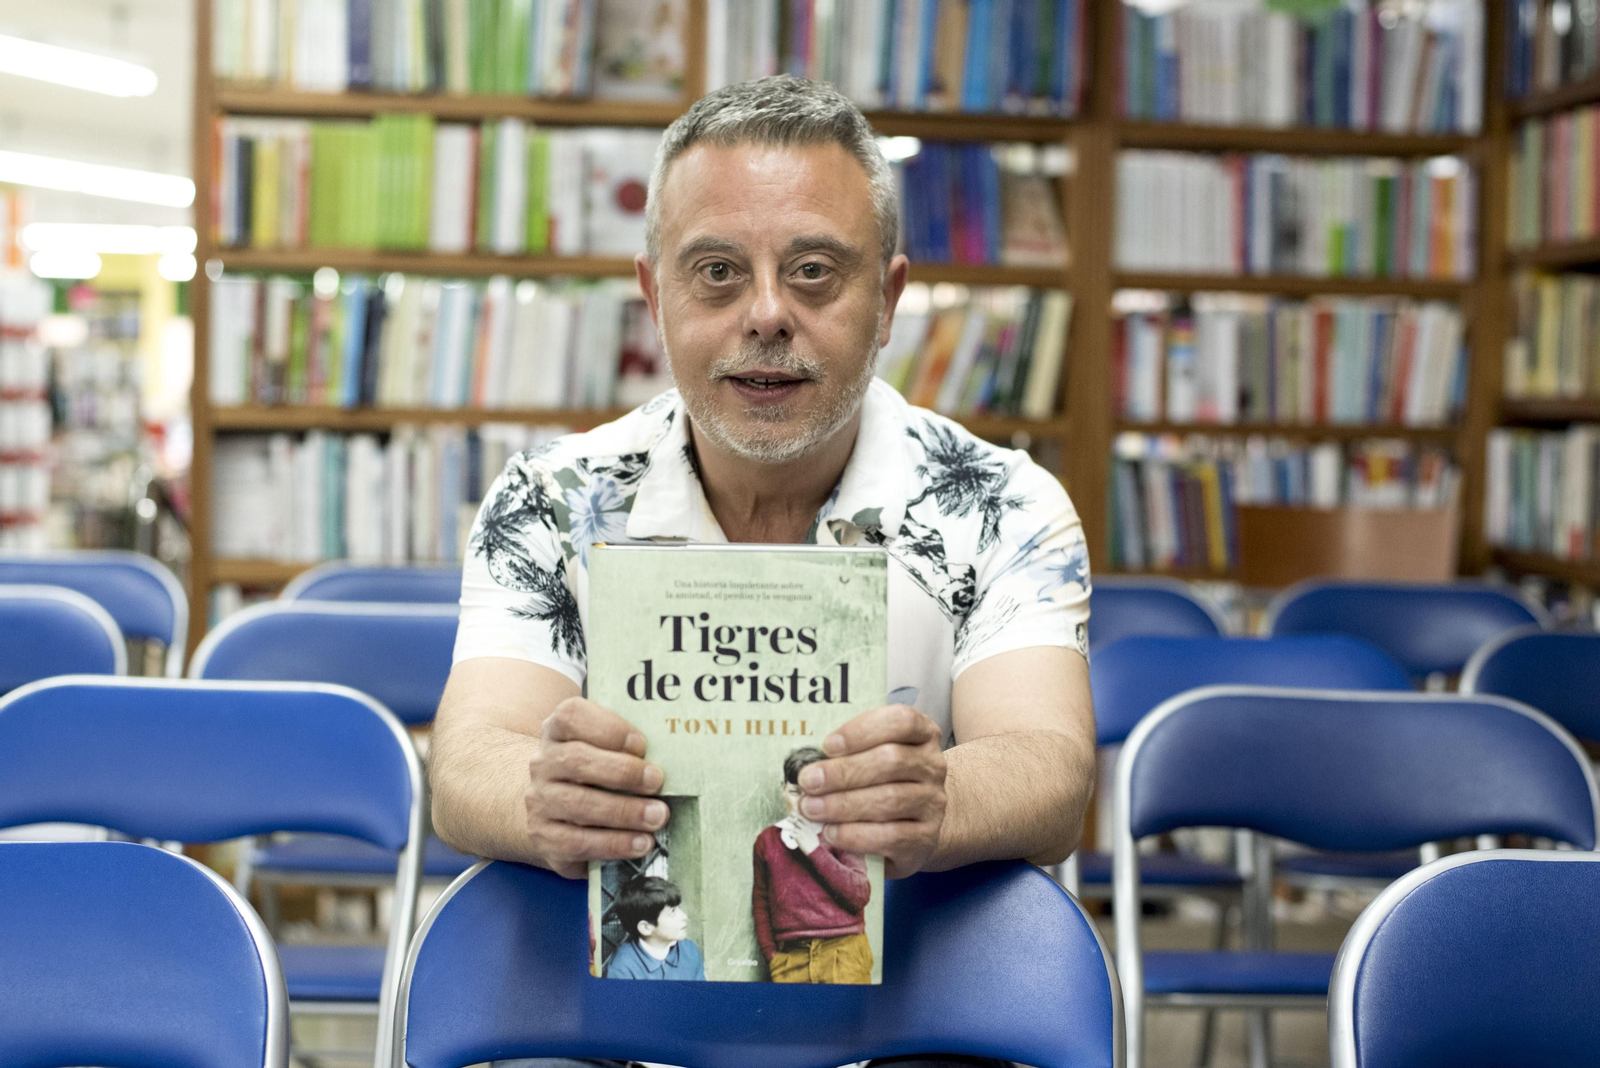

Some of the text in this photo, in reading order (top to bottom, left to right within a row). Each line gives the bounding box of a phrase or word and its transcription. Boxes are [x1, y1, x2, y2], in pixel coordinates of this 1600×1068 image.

[674, 580, 804, 591] Una historia inquietante sobre
[665, 590, 673, 599] la
[714, 591, 722, 599] el
[762, 591, 771, 600] la
[773, 593, 813, 602] venganza
[660, 612, 818, 666] Tigres
[627, 659, 851, 703] de cristal
[665, 718, 814, 736] TONI HILL
